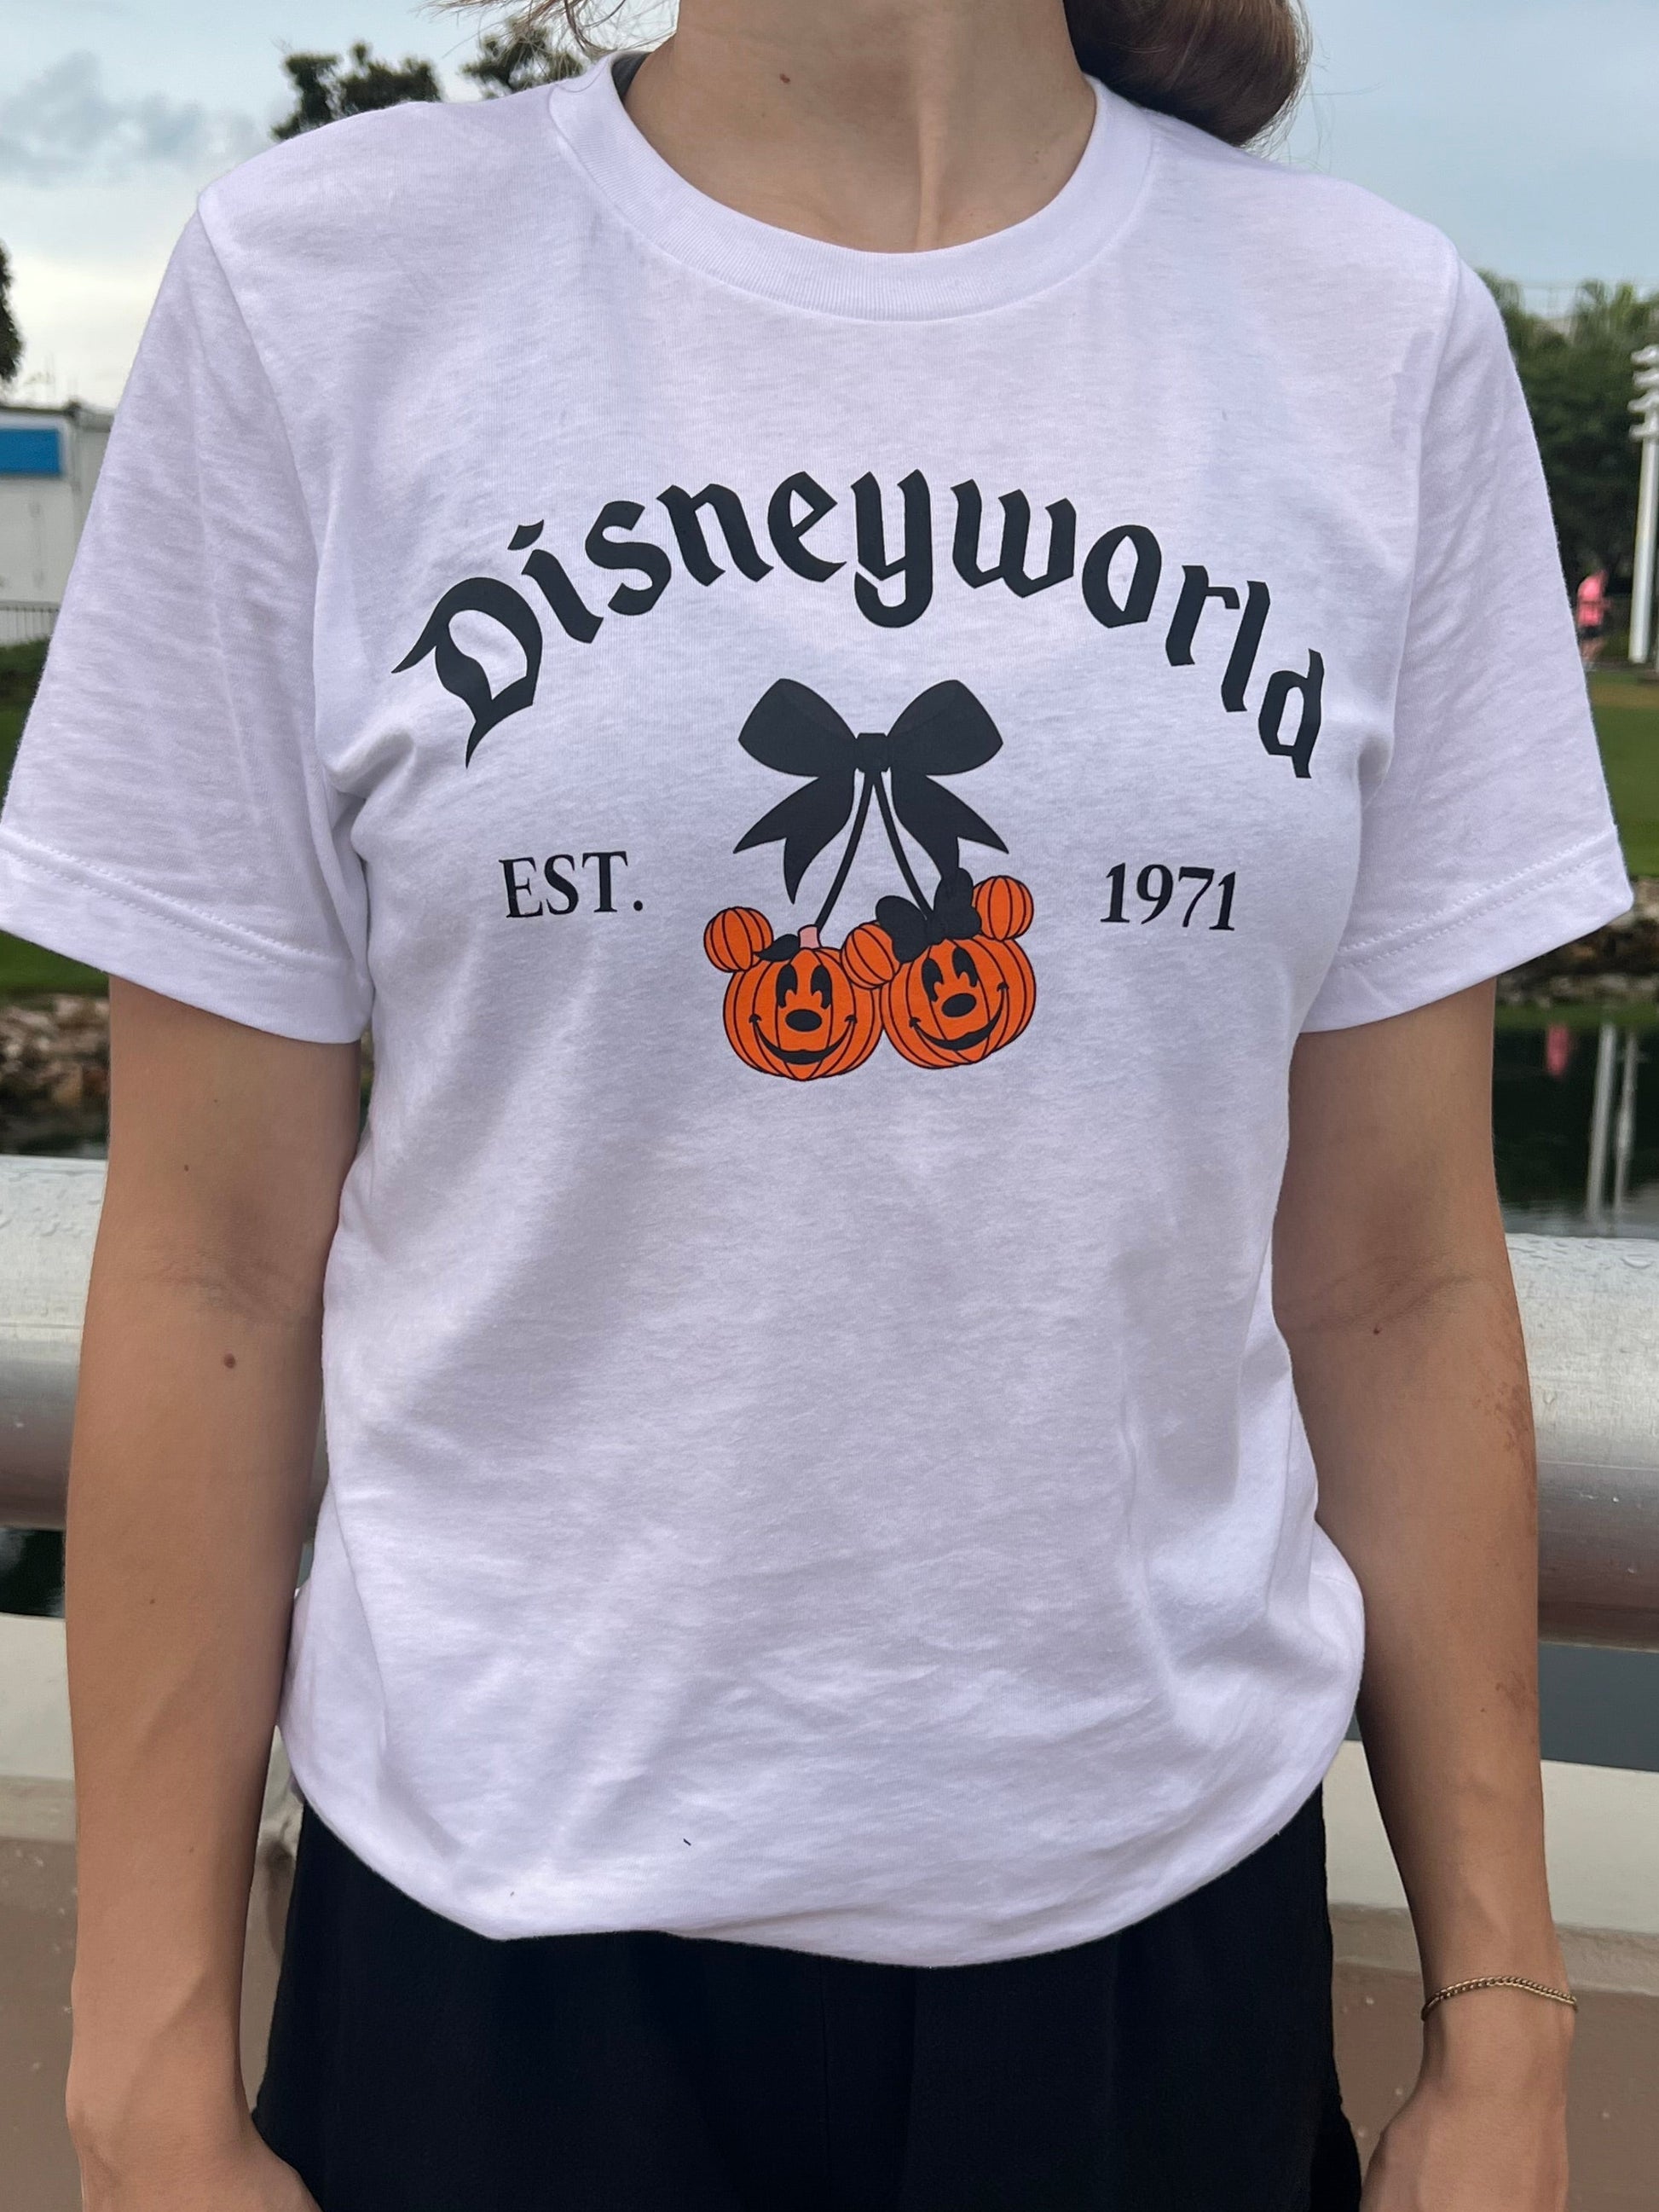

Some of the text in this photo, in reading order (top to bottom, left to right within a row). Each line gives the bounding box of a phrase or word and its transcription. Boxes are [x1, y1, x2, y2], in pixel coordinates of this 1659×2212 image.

[391, 469, 1324, 779] Disneyworld
[499, 851, 1236, 931] EST. 1971
